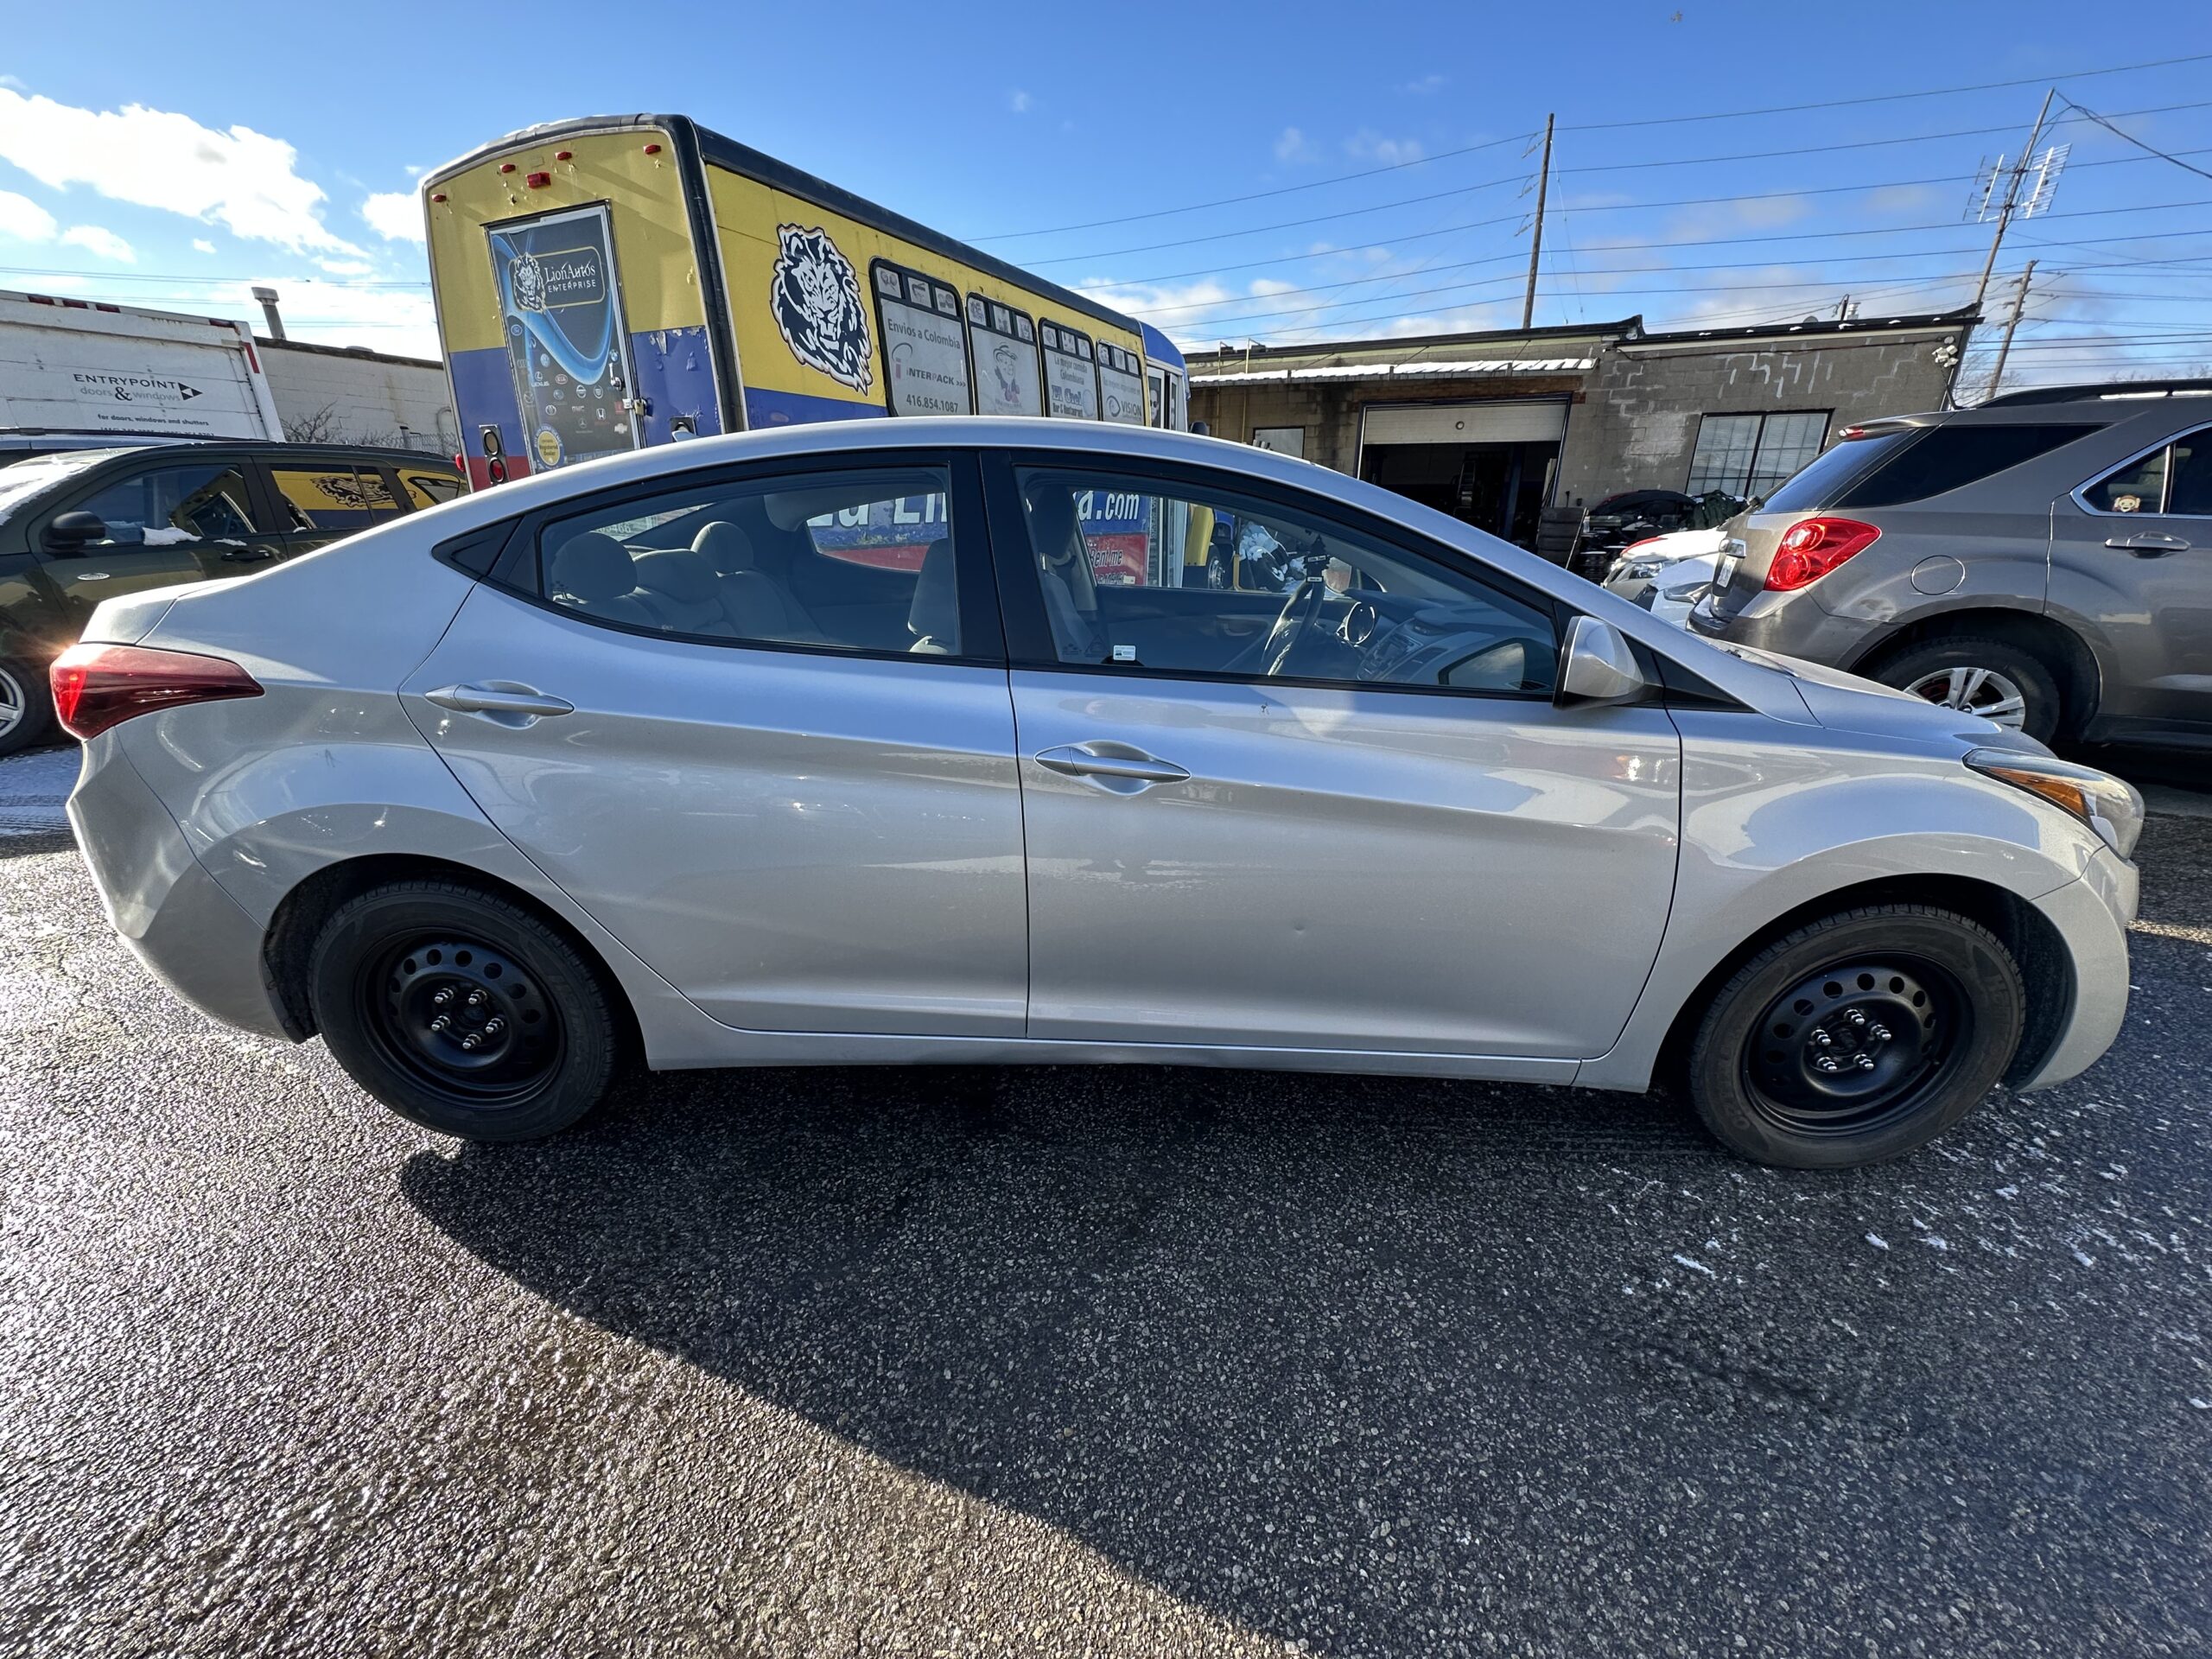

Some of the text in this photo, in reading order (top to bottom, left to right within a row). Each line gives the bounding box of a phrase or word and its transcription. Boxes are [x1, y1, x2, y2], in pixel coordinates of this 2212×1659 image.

[548, 279, 597, 293] ENTERPRISE
[887, 318, 961, 350] Envios a Colombia
[73, 373, 176, 389] ENTRYPOINT
[80, 386, 181, 402] doors & windows
[906, 394, 958, 413] 416.854.1087
[1121, 400, 1141, 416] VISION
[1109, 549, 1123, 567] me
